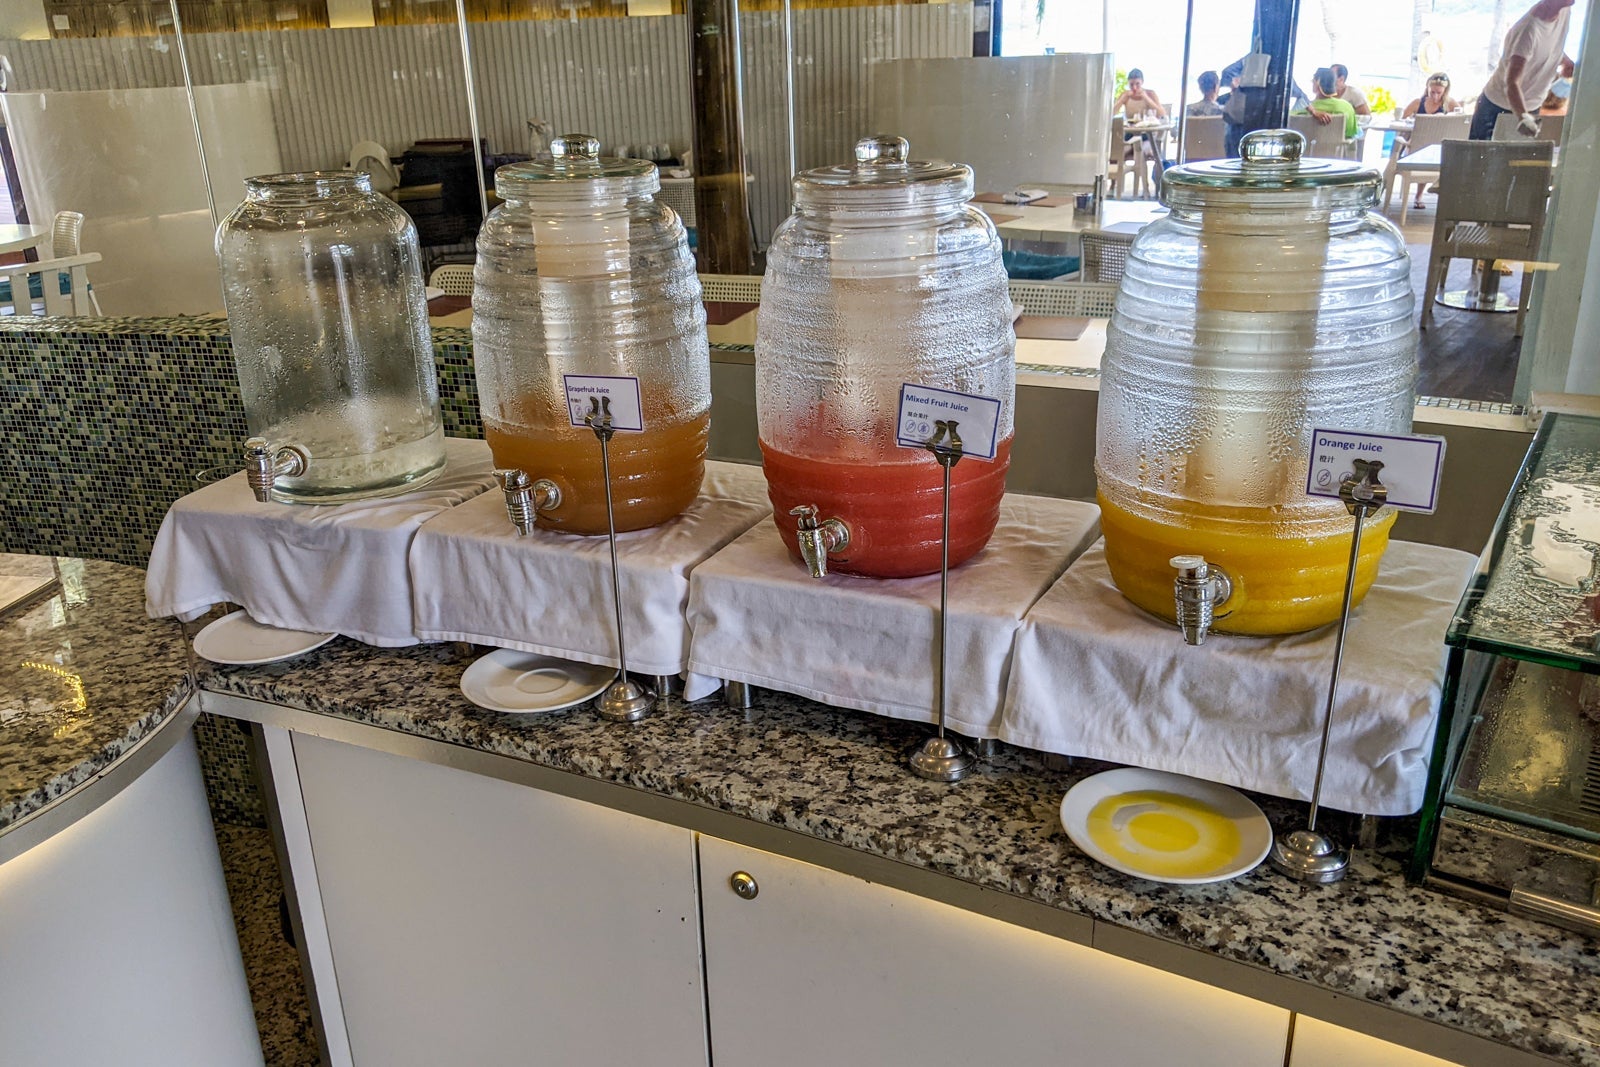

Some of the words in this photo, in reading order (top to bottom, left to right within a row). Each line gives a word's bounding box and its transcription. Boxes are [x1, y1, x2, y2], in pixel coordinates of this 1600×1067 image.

[568, 385, 595, 393] Grapefruit
[596, 386, 610, 394] Juice
[905, 394, 929, 405] Mixed
[930, 398, 949, 409] Fruit
[950, 402, 969, 412] Juice
[1319, 437, 1355, 450] Orange
[1357, 442, 1383, 452] Juice
